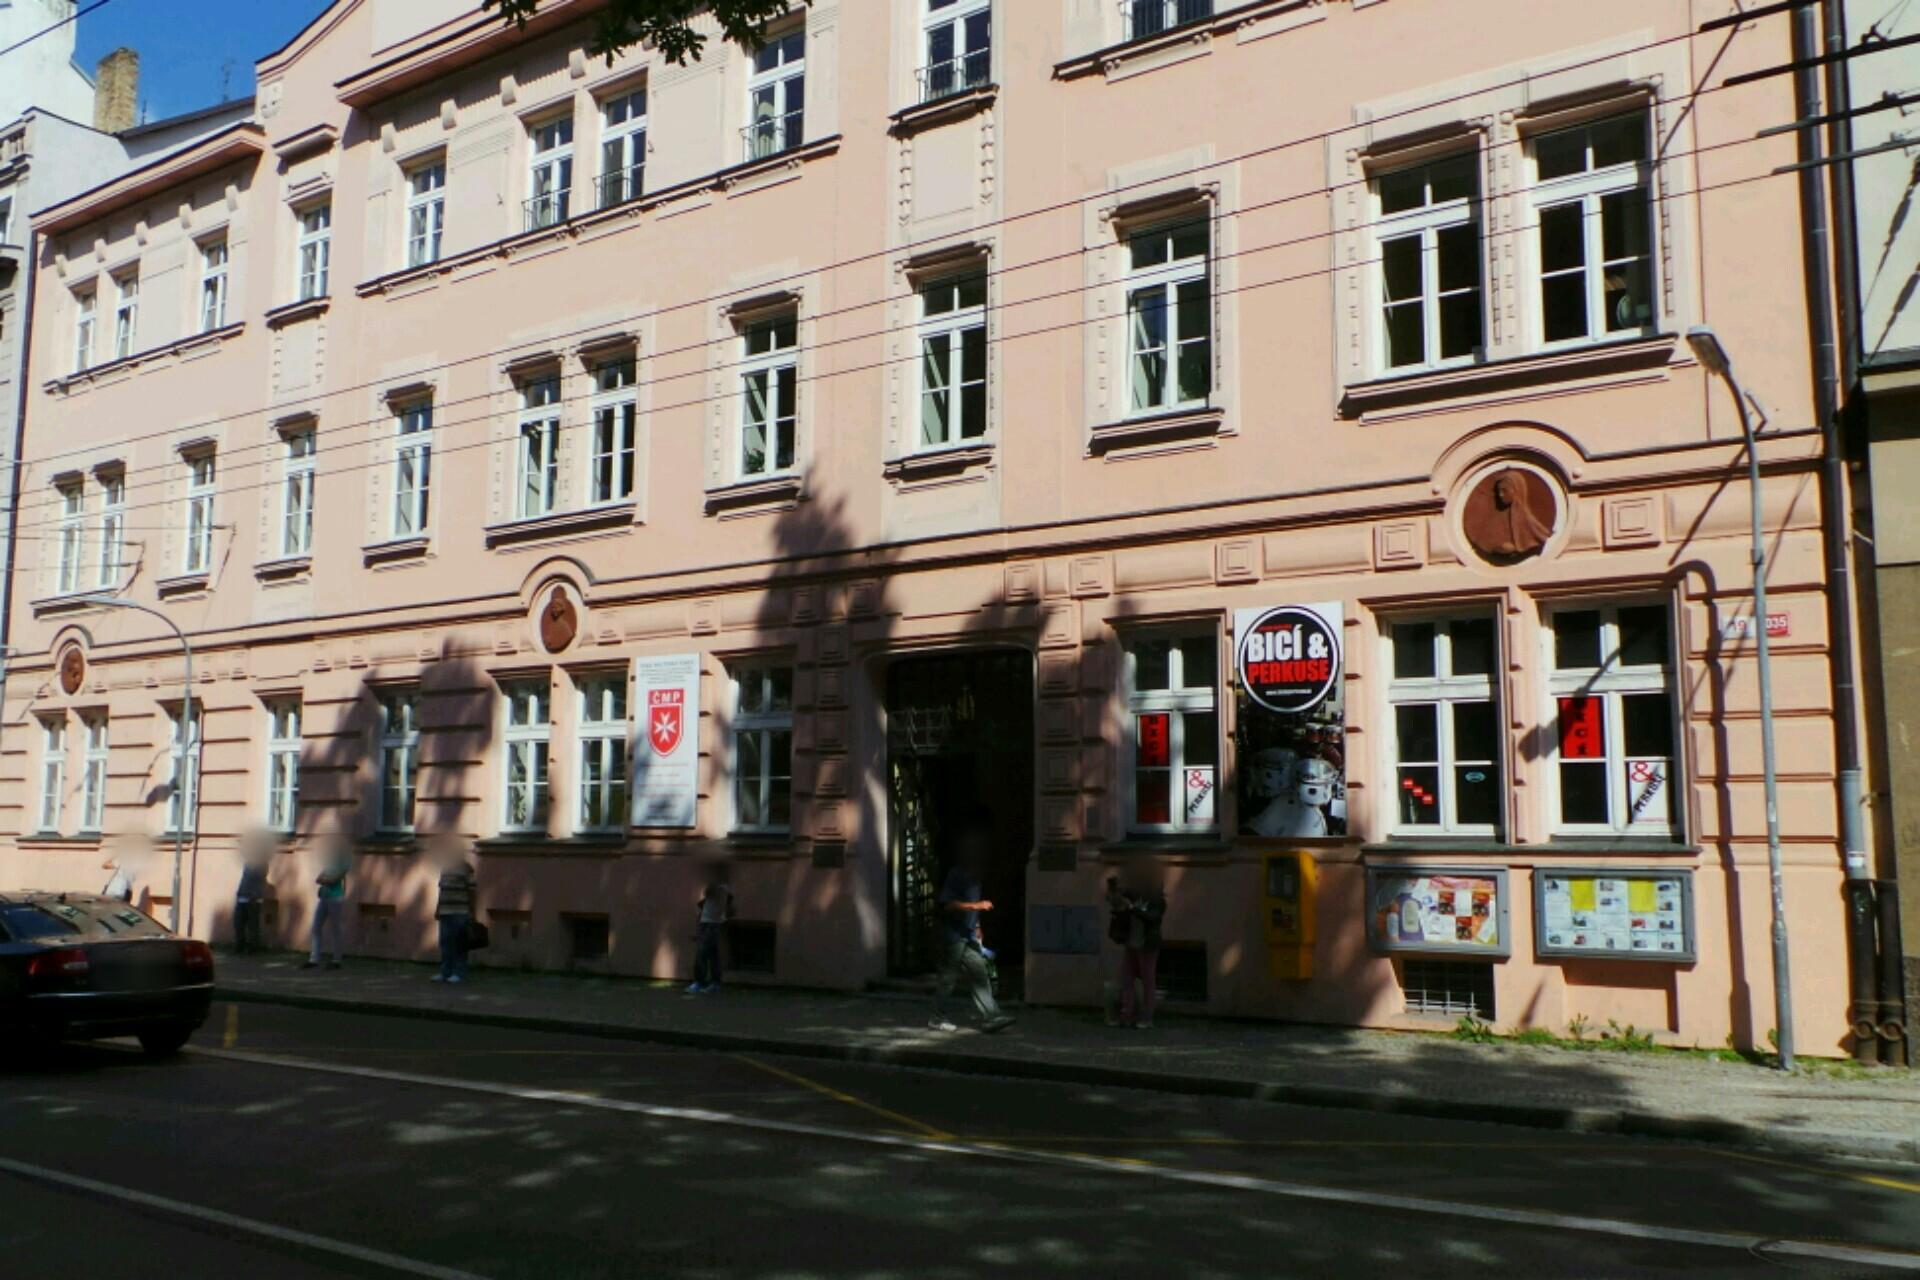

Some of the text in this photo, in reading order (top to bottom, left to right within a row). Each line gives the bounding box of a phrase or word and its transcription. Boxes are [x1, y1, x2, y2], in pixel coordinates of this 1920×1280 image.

[1246, 623, 1328, 663] BICÍ &
[1246, 657, 1329, 684] PERKUSE
[1188, 769, 1206, 788] &
[1631, 760, 1654, 783] &
